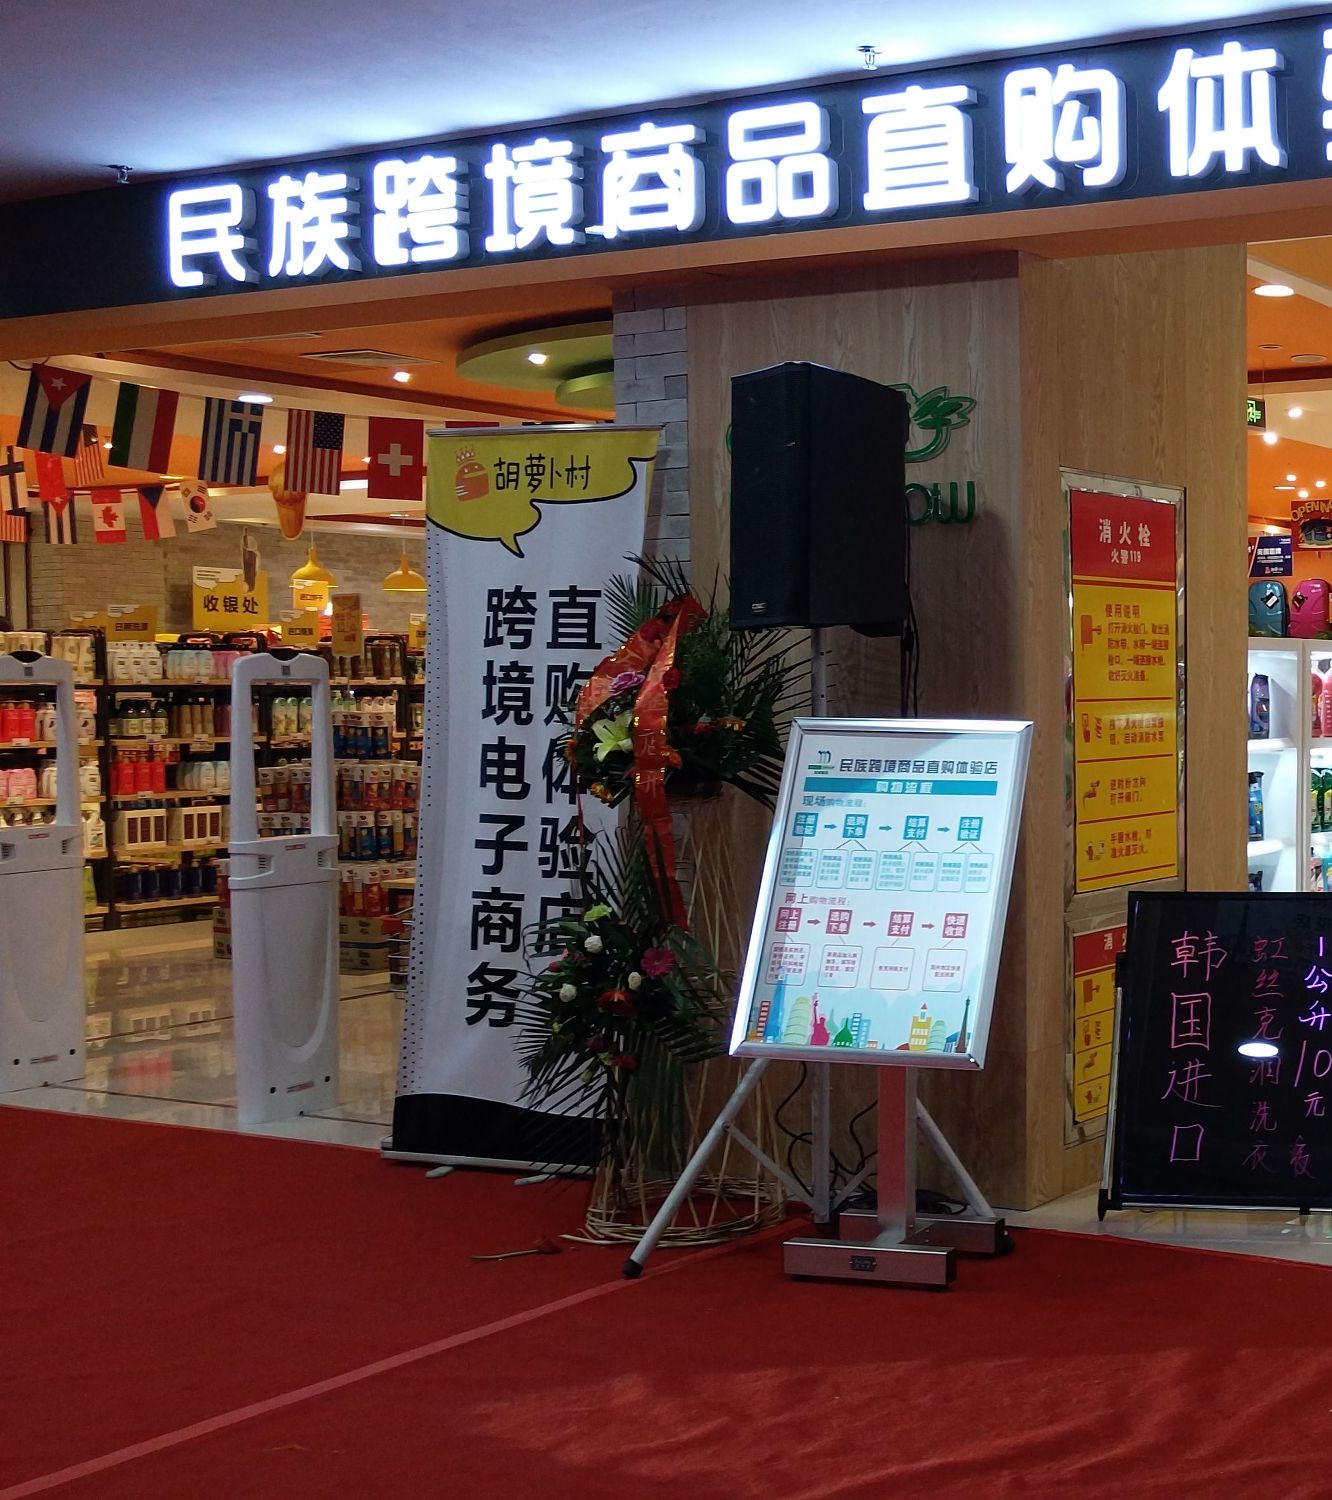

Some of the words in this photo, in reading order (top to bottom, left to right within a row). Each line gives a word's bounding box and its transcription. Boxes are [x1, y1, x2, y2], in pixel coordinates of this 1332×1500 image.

[494, 453, 591, 493] 胡萝卜村
[1099, 518, 1151, 547] 消火栓
[1111, 548, 1141, 565] 火警119
[203, 594, 259, 615] 收银处
[839, 758, 998, 775] 民族跨境商品直购体验店
[464, 585, 538, 1030] 跨境电子商务
[1161, 930, 1228, 1162] 韩国进口
